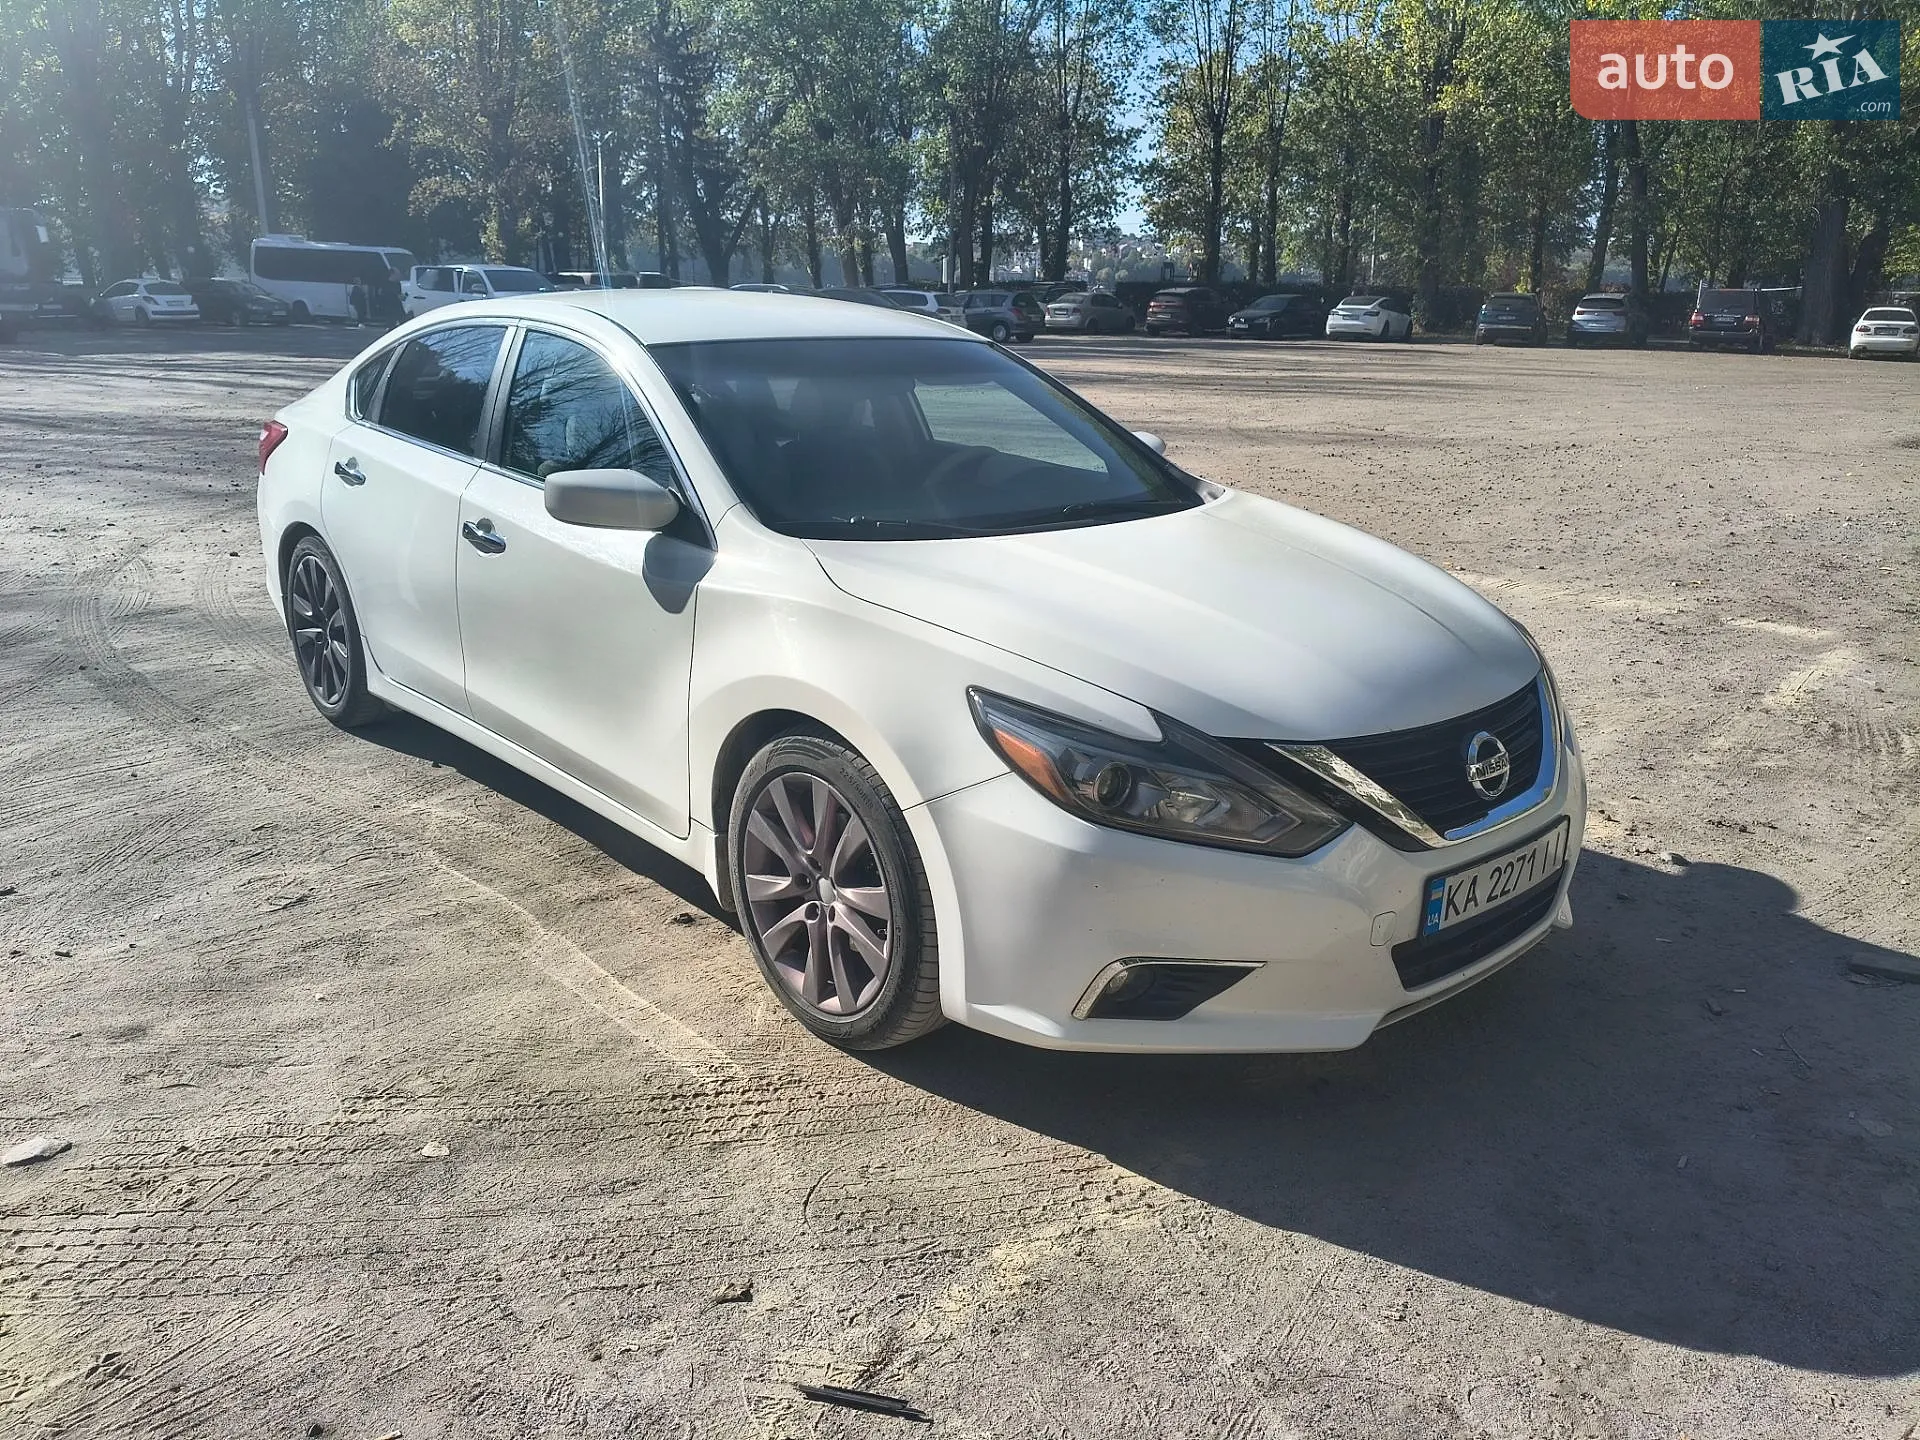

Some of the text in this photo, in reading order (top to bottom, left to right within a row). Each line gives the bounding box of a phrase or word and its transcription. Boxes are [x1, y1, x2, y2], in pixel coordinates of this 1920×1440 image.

[1444, 832, 1560, 921] KA 2271 II
[1427, 912, 1439, 926] UA
